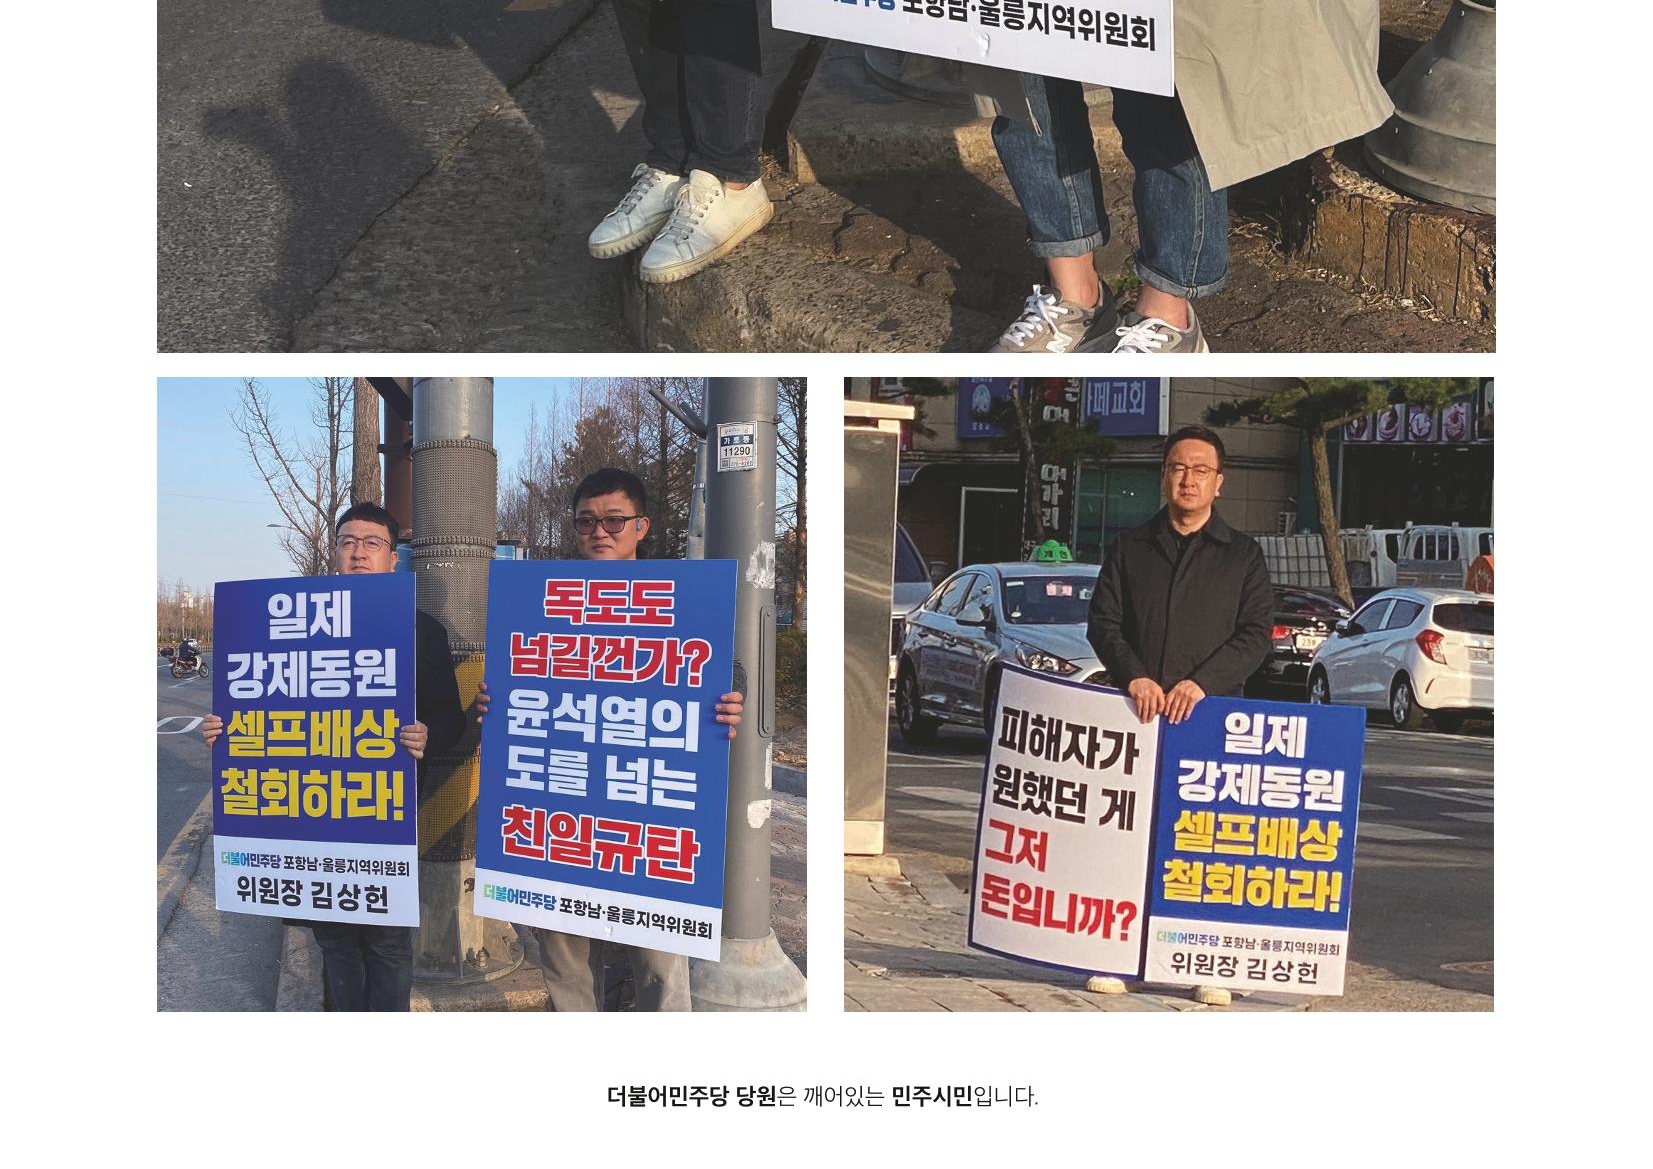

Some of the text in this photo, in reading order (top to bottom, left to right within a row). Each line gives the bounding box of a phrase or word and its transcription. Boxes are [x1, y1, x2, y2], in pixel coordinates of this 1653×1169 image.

[723, 446, 751, 457] 11290
[267, 590, 352, 640] 일제
[543, 579, 675, 627] 독도도
[227, 648, 397, 699] 강제동원
[509, 632, 713, 688] 넘길껀가?
[226, 709, 400, 759] 셀프배상
[506, 688, 701, 753] 윤석열의
[997, 706, 1140, 776] 피해자가
[1224, 712, 1308, 759] 일제
[221, 767, 404, 822] 철회하라!
[505, 745, 697, 811] 도를 넘는
[992, 763, 1136, 832] 원했던 게
[1178, 759, 1345, 813] 강제동원
[500, 803, 701, 884] 친일규탄
[985, 818, 1049, 872] 그저
[1173, 809, 1344, 863] 셀프배상
[221, 851, 411, 878] 더불어민주당 포항남·울릉지역위원회
[1162, 859, 1343, 913] 철회하라!
[236, 876, 389, 914] 위원장 김상헌
[483, 883, 713, 940] 더불어민주당 포항남·울릉지역위원회
[981, 872, 1138, 942] 돈입니까?
[1156, 929, 1221, 947] 더불어민주당
[1170, 951, 1318, 985] 위원장 김상헌
